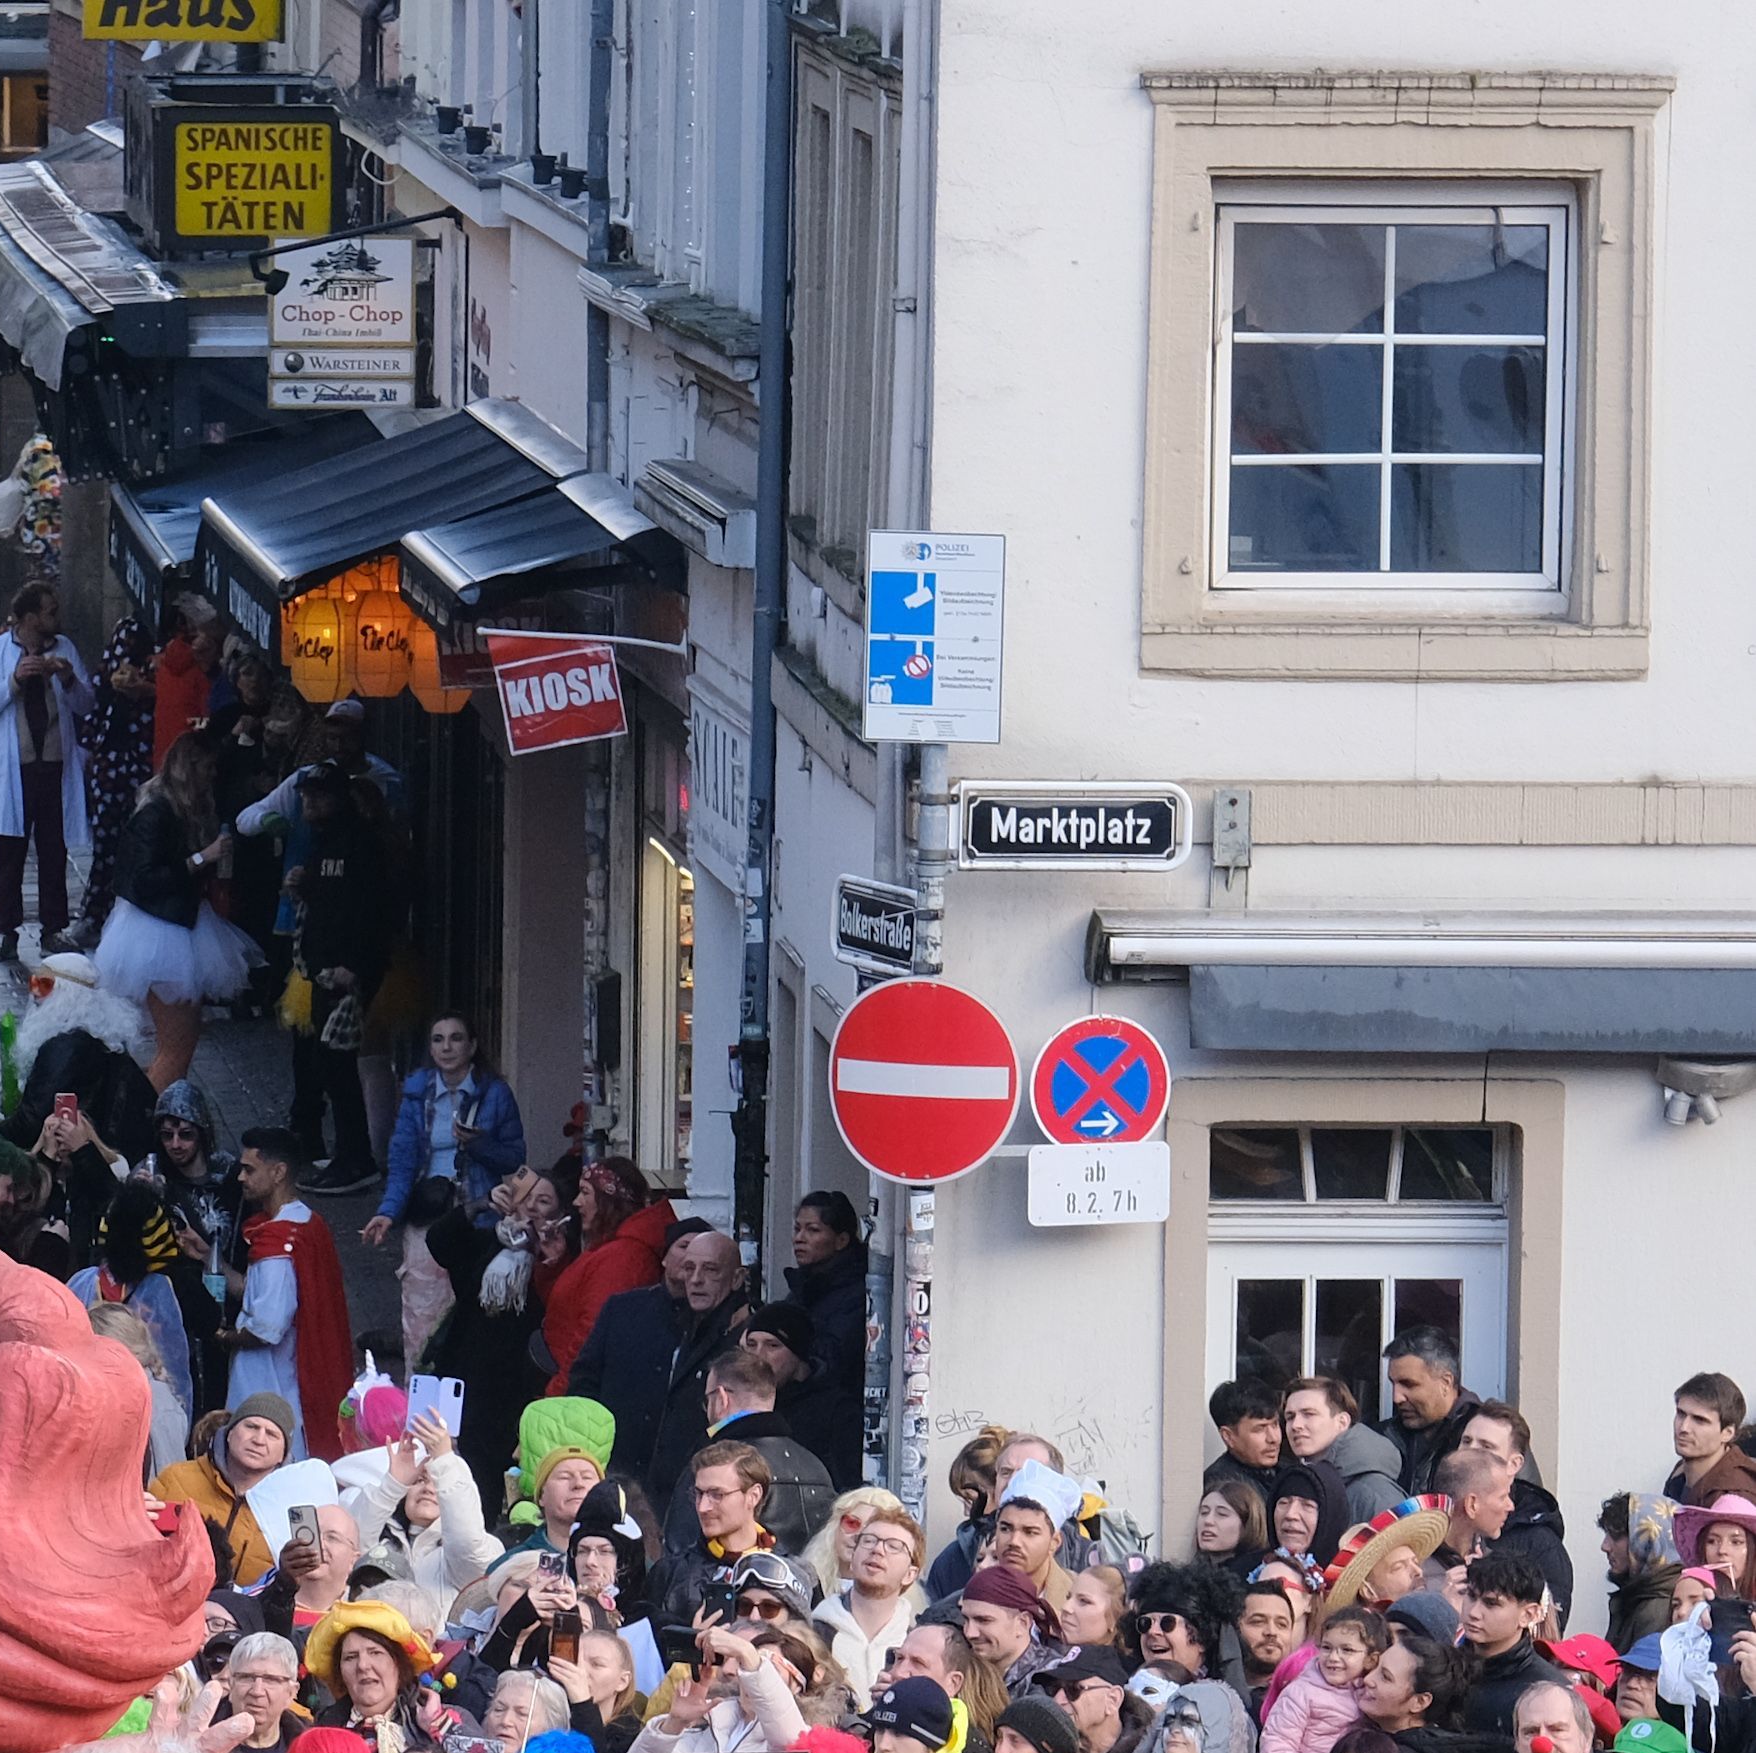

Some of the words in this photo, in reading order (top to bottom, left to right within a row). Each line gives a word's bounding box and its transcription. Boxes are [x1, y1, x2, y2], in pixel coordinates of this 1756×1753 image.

[185, 127, 324, 151] SPANISCHE
[201, 196, 305, 231] TÄTEN
[309, 356, 401, 371] WARSTEINER
[505, 663, 618, 719] KIOSK
[990, 806, 1152, 850] Marktplatz
[840, 898, 912, 951] Bolkerstraße
[1084, 1160, 1106, 1182] ab
